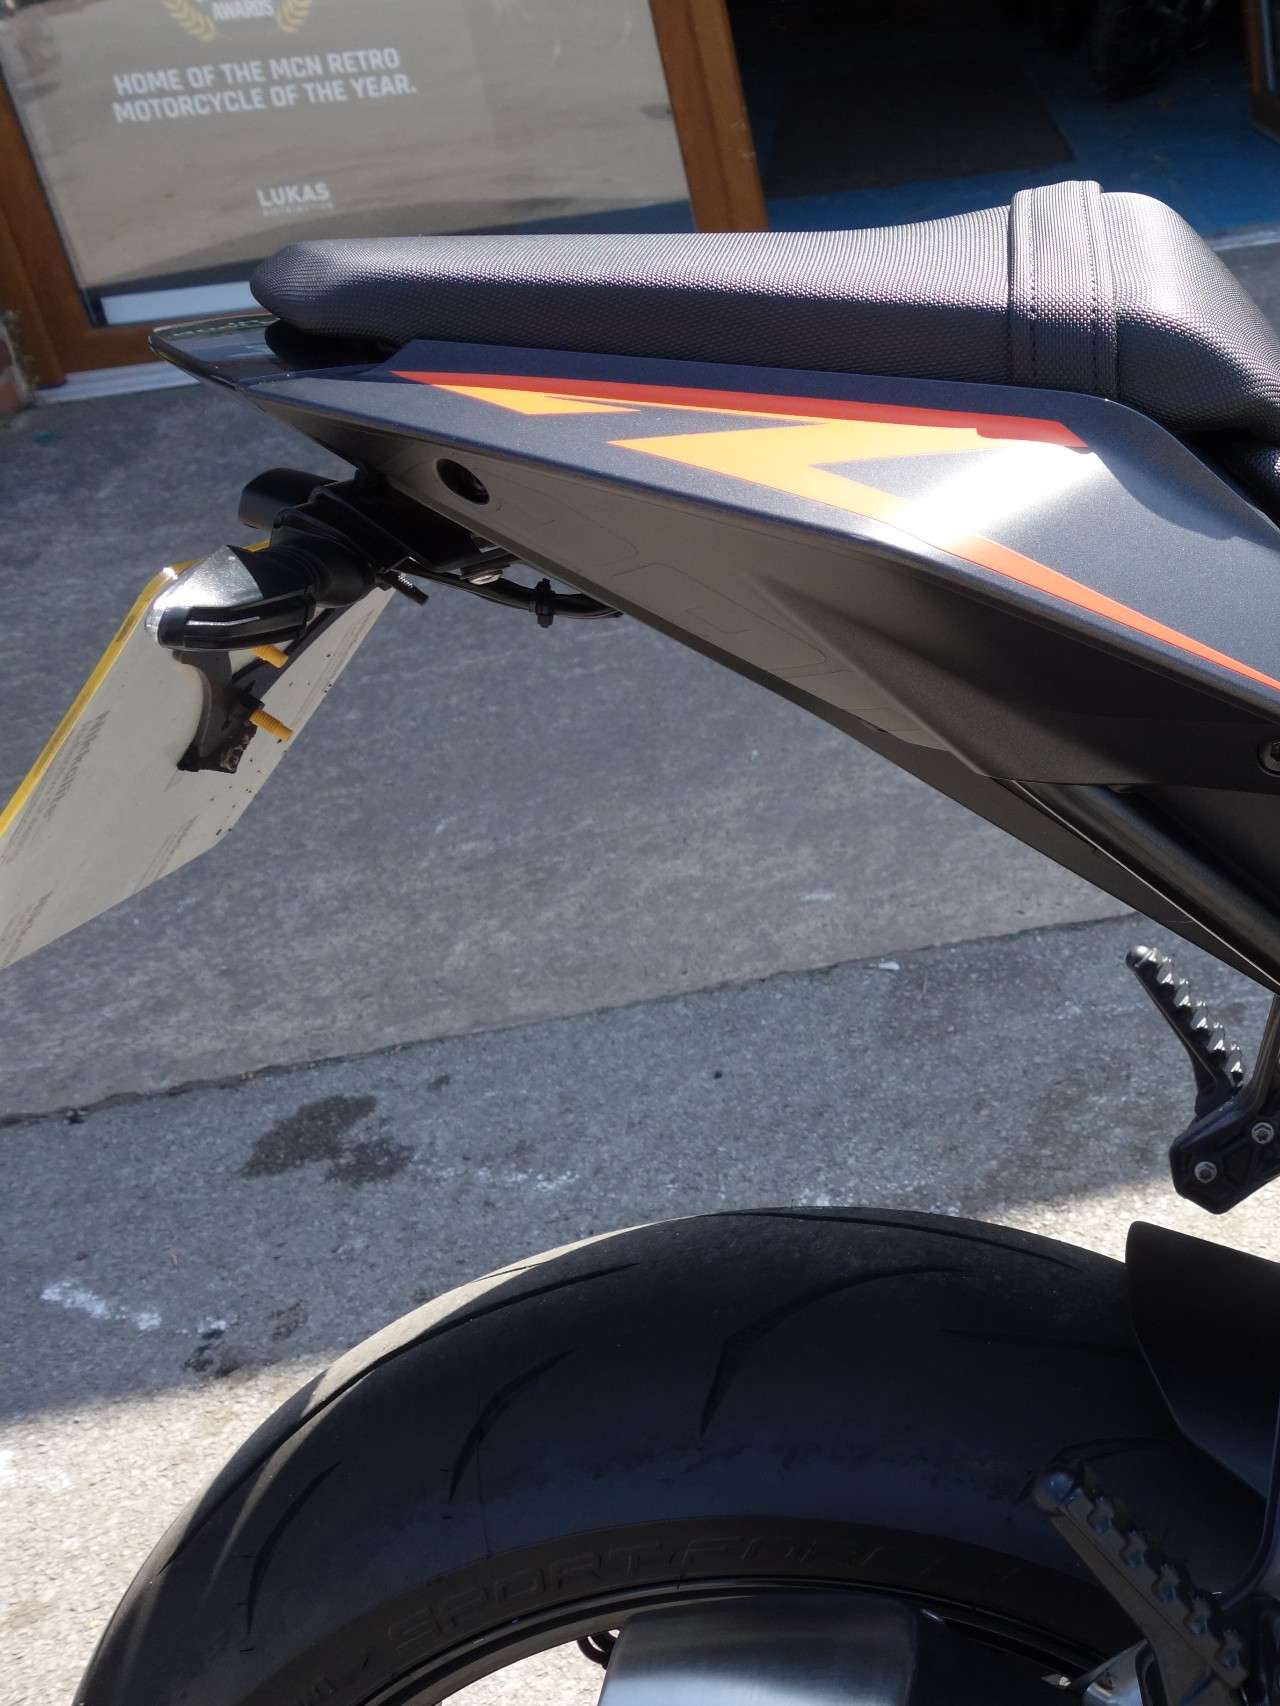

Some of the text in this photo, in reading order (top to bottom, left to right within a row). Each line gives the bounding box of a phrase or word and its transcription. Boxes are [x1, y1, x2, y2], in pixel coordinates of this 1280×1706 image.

[112, 47, 400, 97] HOME OF THE MCN RETRO
[112, 73, 417, 123] MOTORCYCLE OF THE YEAR.
[256, 181, 331, 208] LUKAS
